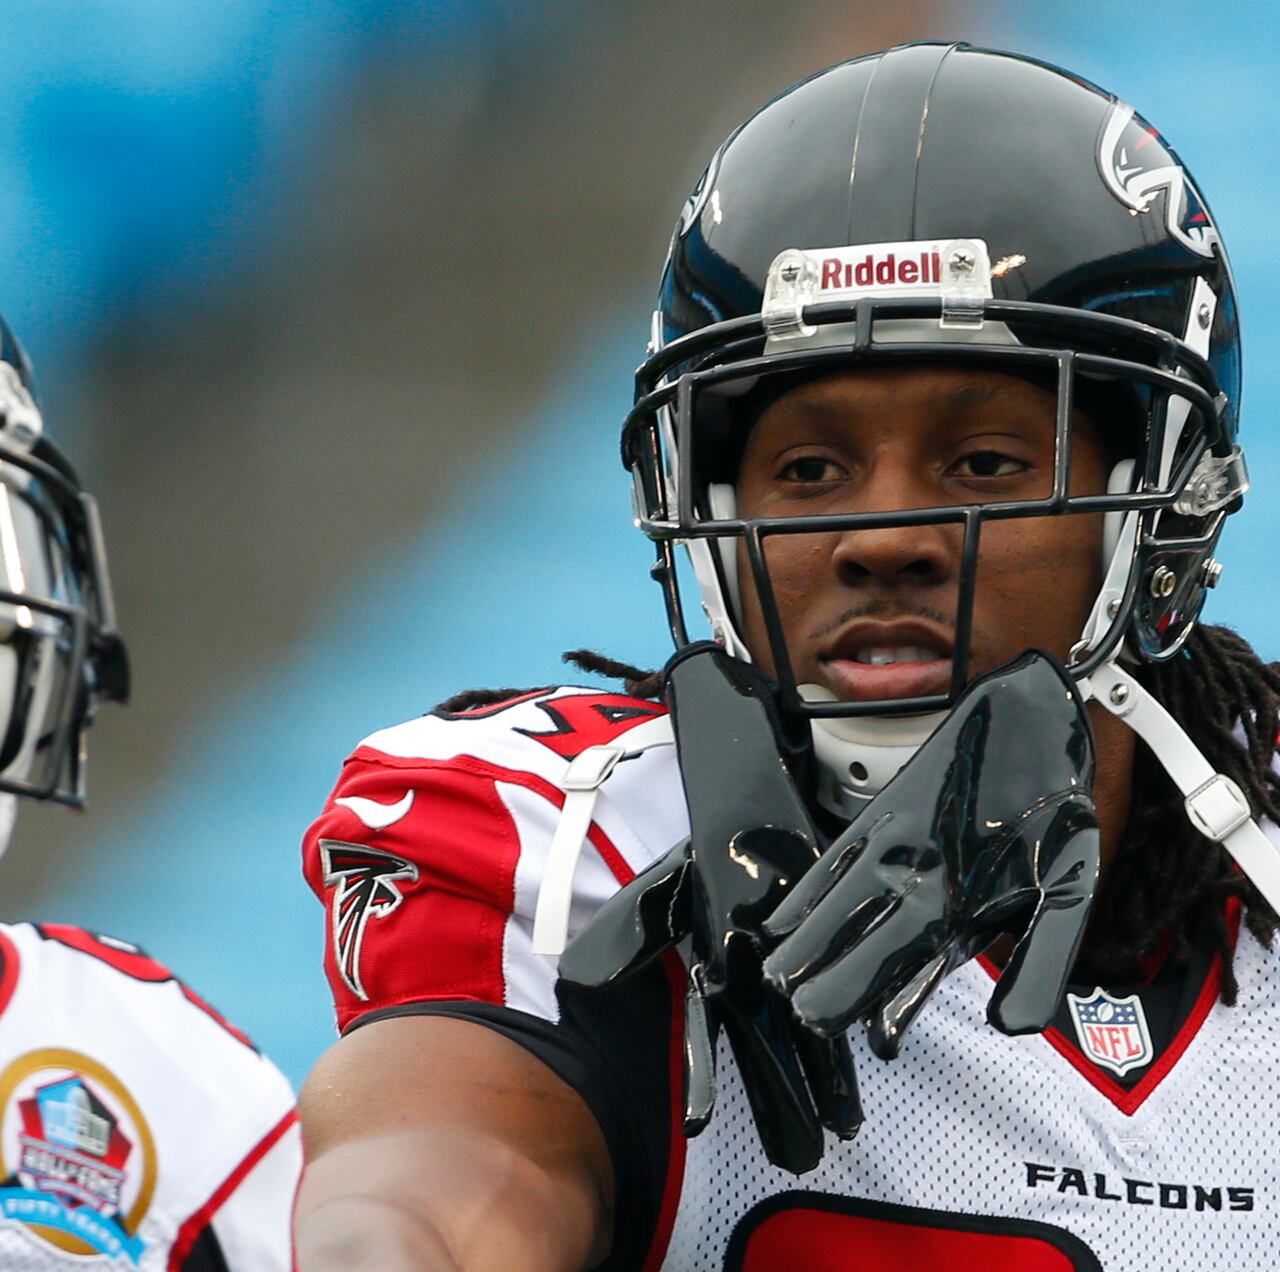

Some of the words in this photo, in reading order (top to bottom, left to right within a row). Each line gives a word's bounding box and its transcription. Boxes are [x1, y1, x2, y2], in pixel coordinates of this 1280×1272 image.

[821, 251, 942, 290] Riddell
[1086, 1025, 1141, 1061] NFL
[1022, 1161, 1255, 1212] FALCONS
